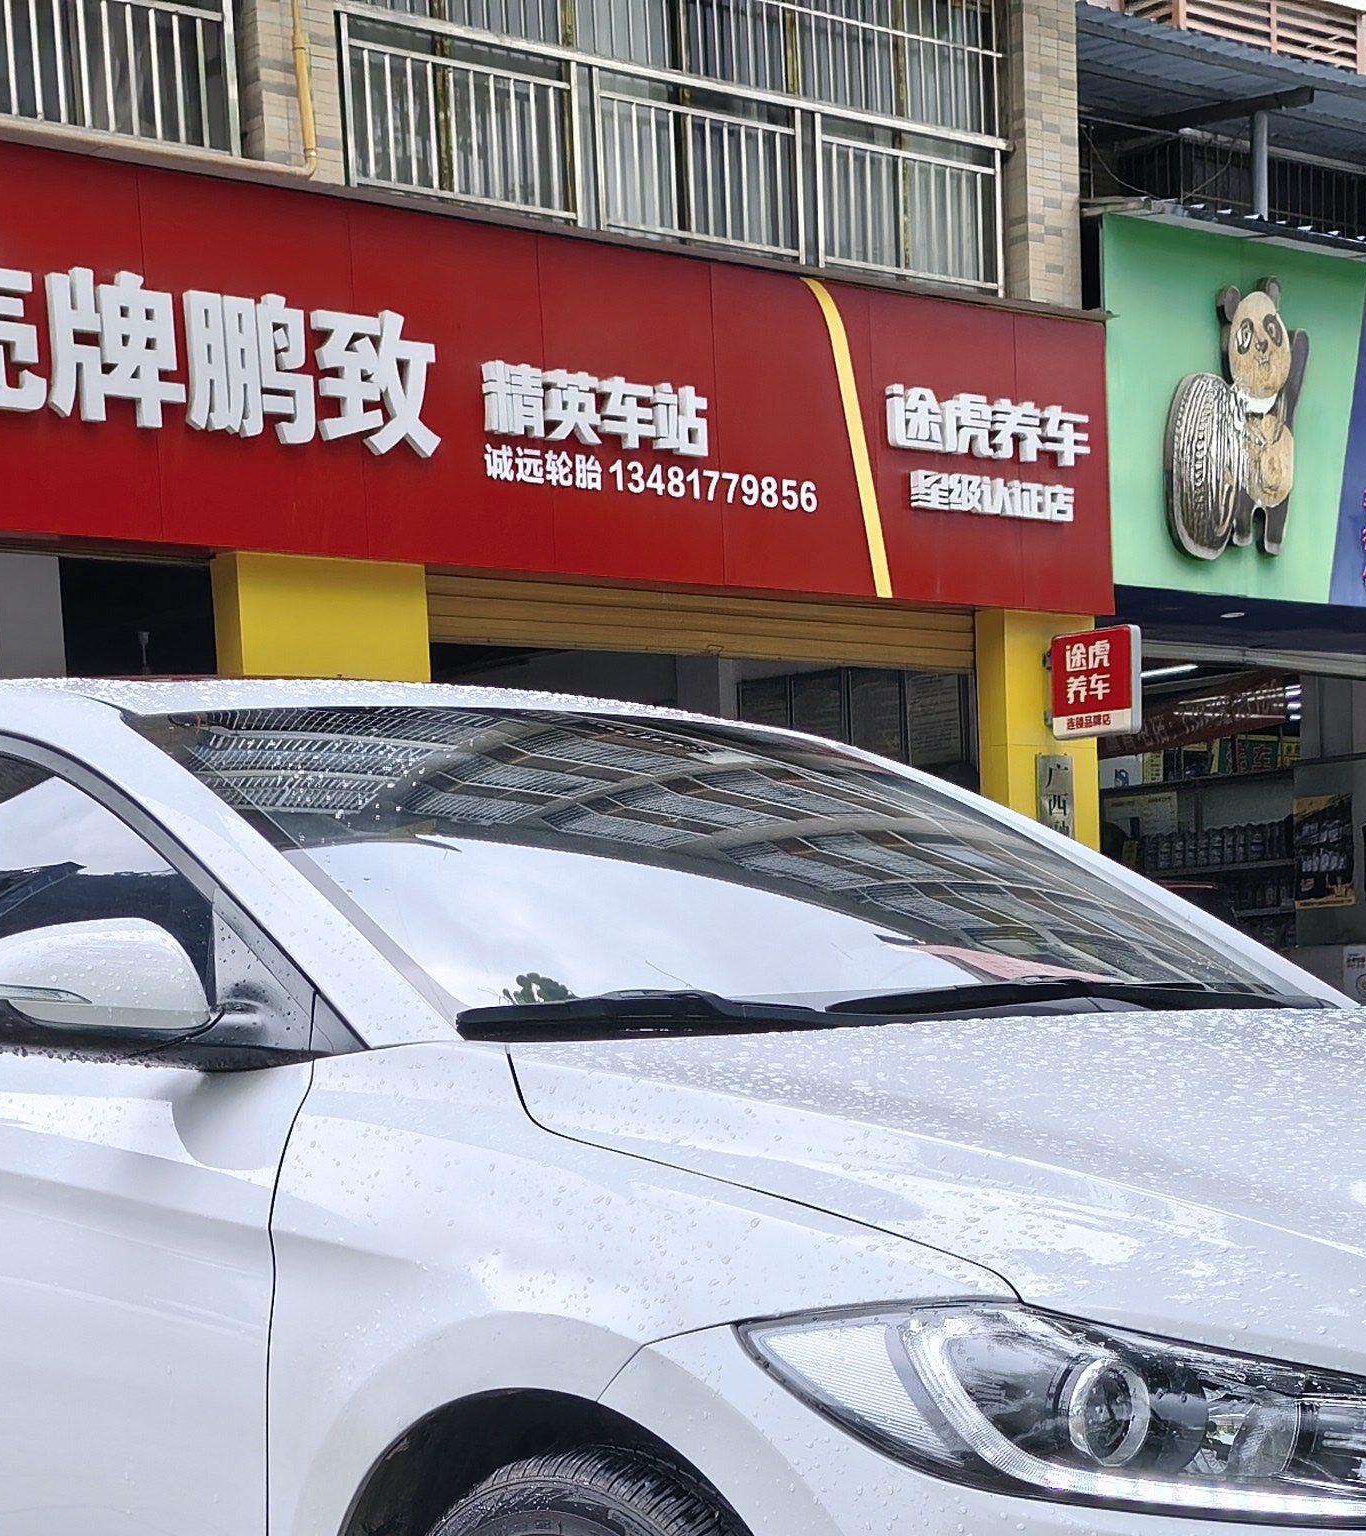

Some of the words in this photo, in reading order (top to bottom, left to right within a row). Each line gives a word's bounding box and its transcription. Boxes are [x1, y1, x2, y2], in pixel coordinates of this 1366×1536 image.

[482, 360, 709, 457] 精英车站
[886, 383, 1090, 467] 途虎养车
[484, 443, 602, 491] 诚远轮胎
[609, 459, 818, 513] 13481779856
[910, 469, 1074, 522] 星级认证店
[1065, 640, 1110, 671] 途虎
[1066, 673, 1111, 705] 养车
